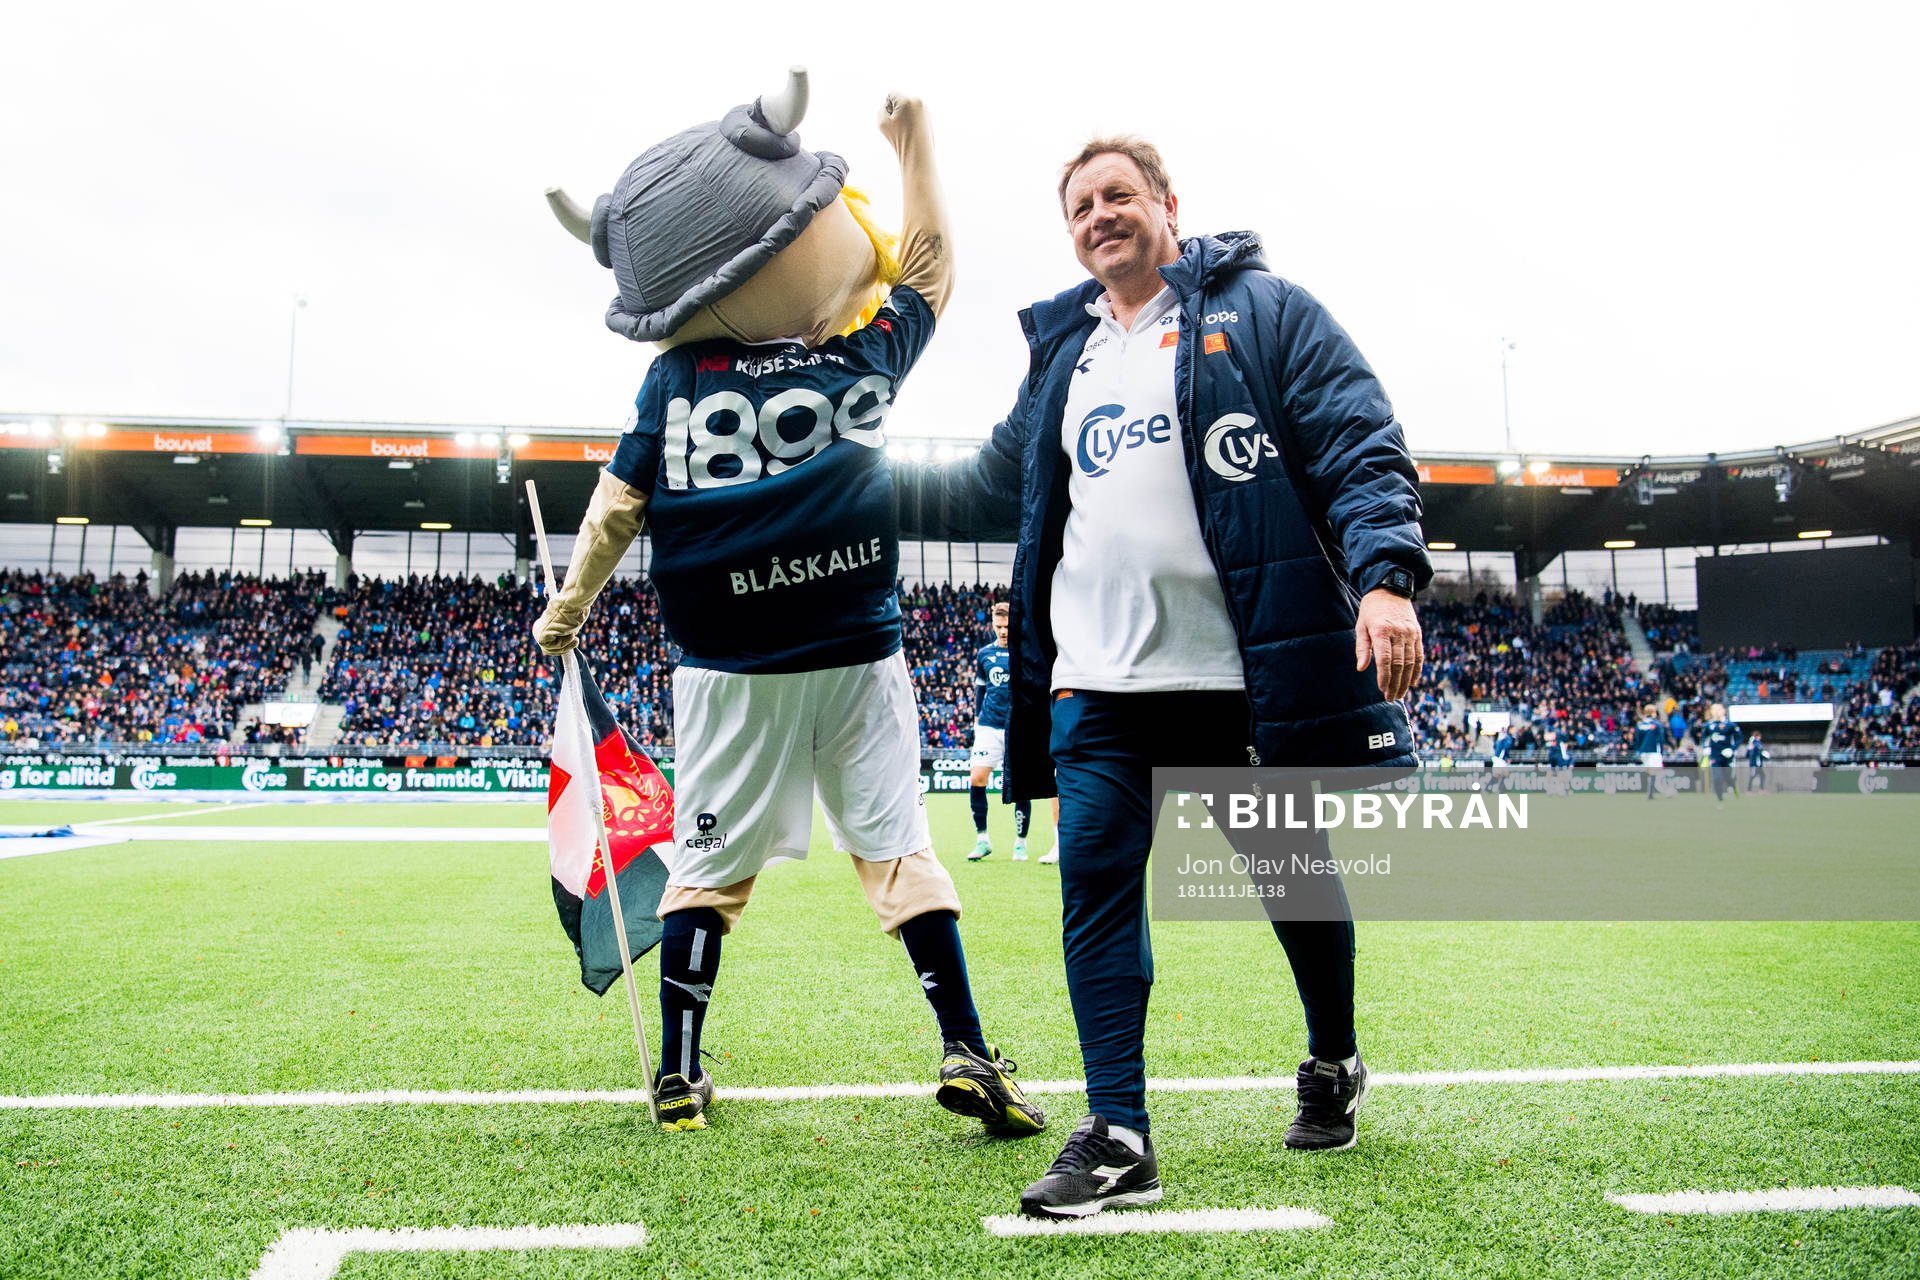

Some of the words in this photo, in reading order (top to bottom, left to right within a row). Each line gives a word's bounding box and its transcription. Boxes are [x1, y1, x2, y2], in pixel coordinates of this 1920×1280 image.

[154, 433, 213, 451] bouvet
[371, 439, 428, 457] bouvet
[583, 444, 616, 461] bou
[730, 537, 882, 595] BLÅSKALLE
[1368, 732, 1396, 750] BB
[20, 766, 54, 786] for
[56, 766, 115, 787] alltid
[303, 768, 369, 787] Fortid
[373, 774, 402, 791] og
[406, 768, 492, 790] framtid,
[496, 769, 551, 788] Vikin
[686, 833, 727, 852] cegal
